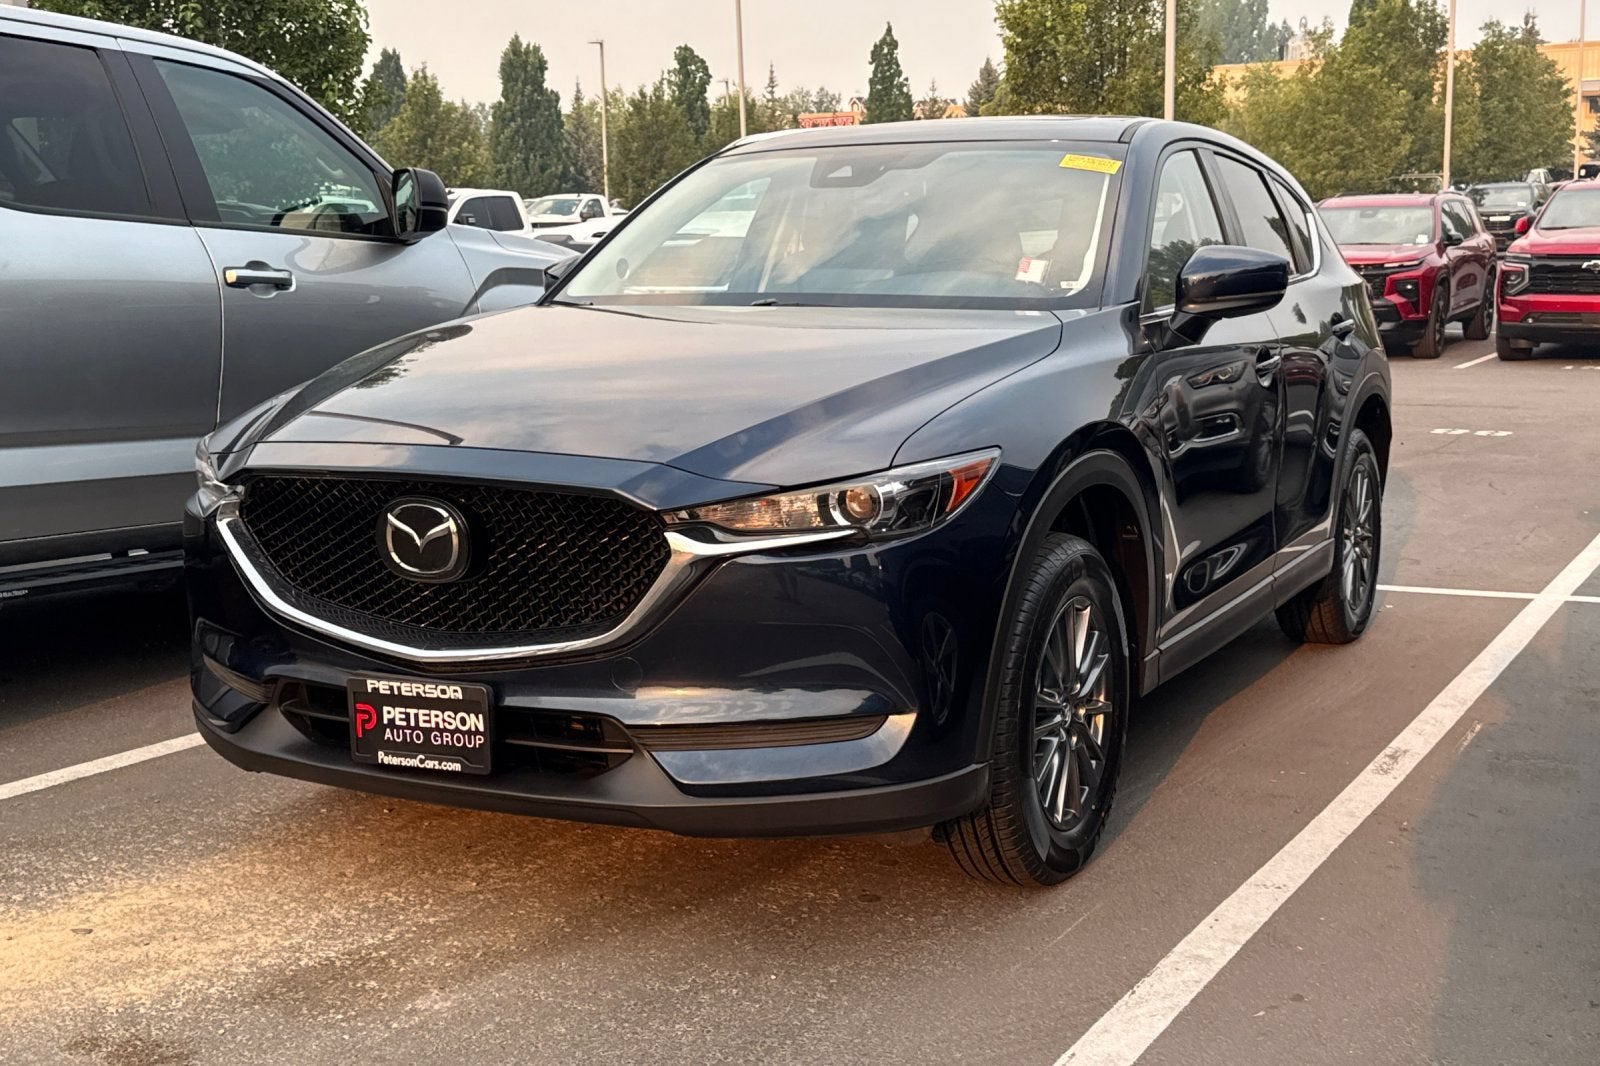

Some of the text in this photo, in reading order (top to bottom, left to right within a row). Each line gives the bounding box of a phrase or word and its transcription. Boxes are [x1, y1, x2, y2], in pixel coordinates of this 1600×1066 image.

[382, 706, 485, 732] PETERSON
[384, 728, 485, 748] AUTO GROUP
[377, 751, 462, 772] PetersonCars.com
